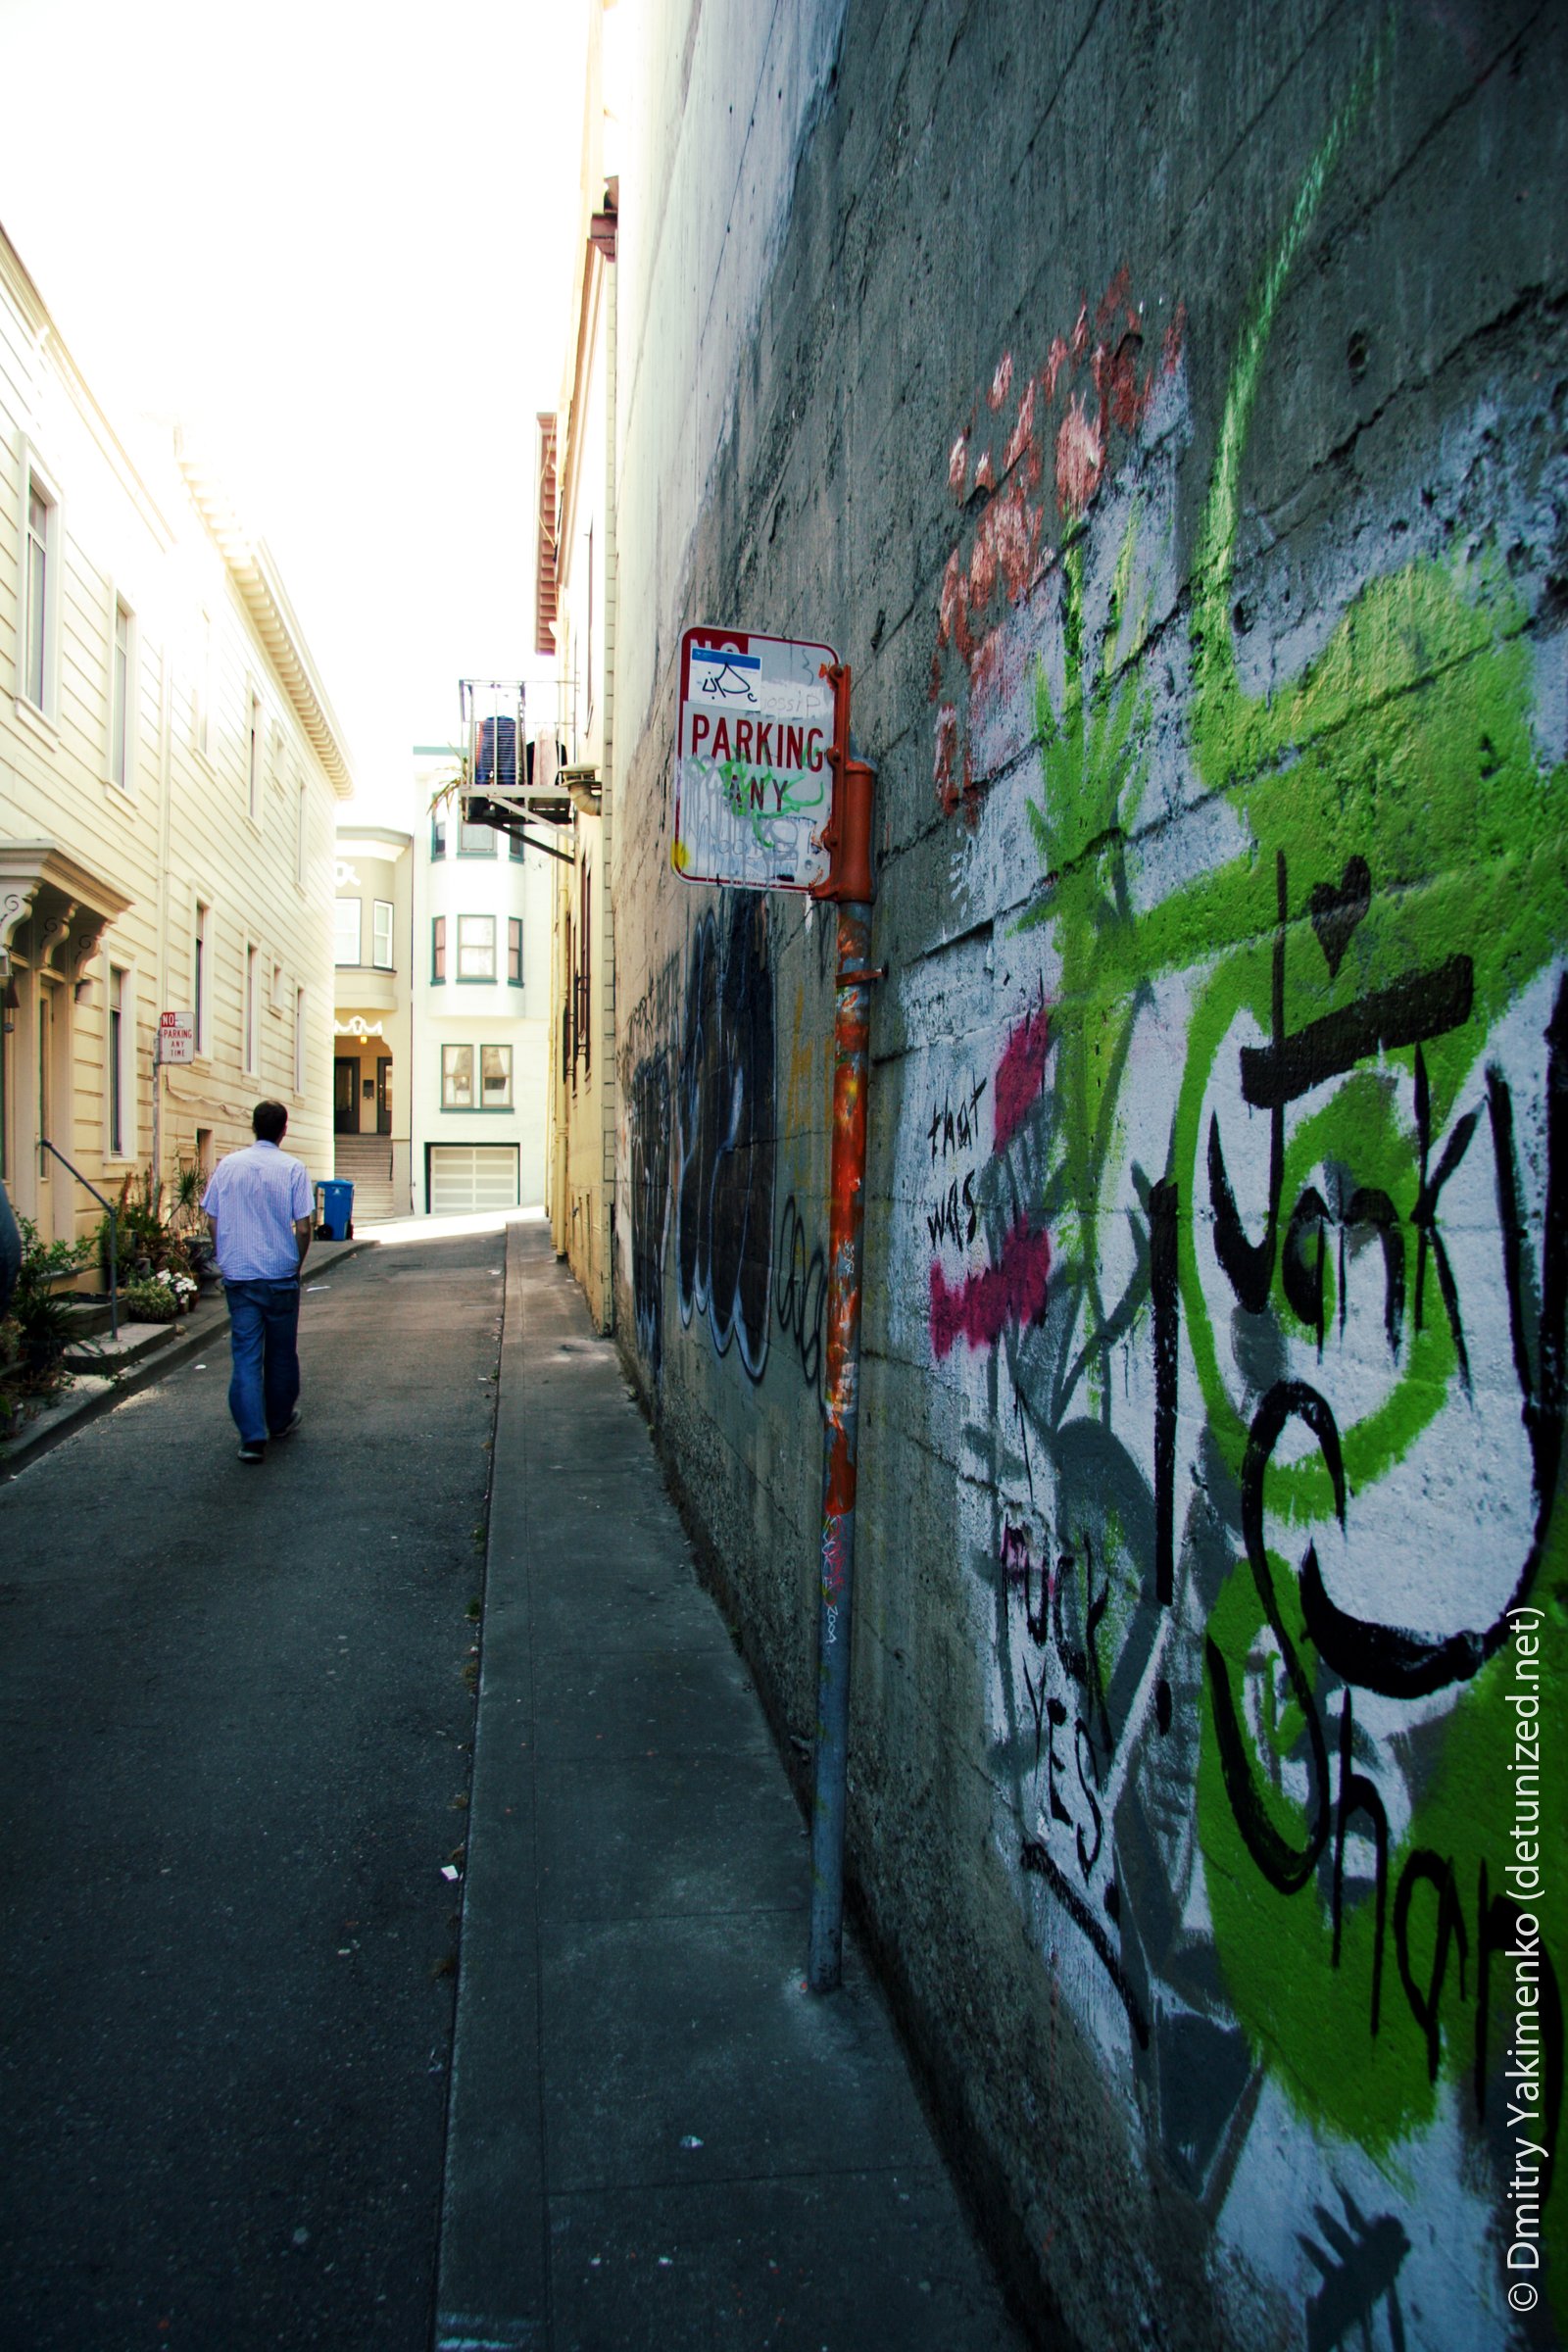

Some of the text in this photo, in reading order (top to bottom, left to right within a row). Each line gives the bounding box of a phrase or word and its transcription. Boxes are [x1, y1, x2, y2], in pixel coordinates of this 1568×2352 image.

[692, 713, 824, 772] PARKING
[728, 774, 789, 812] ANY
[163, 1014, 174, 1026] NO
[164, 1029, 192, 1038] PARKING
[1021, 1652, 1103, 1885] YES
